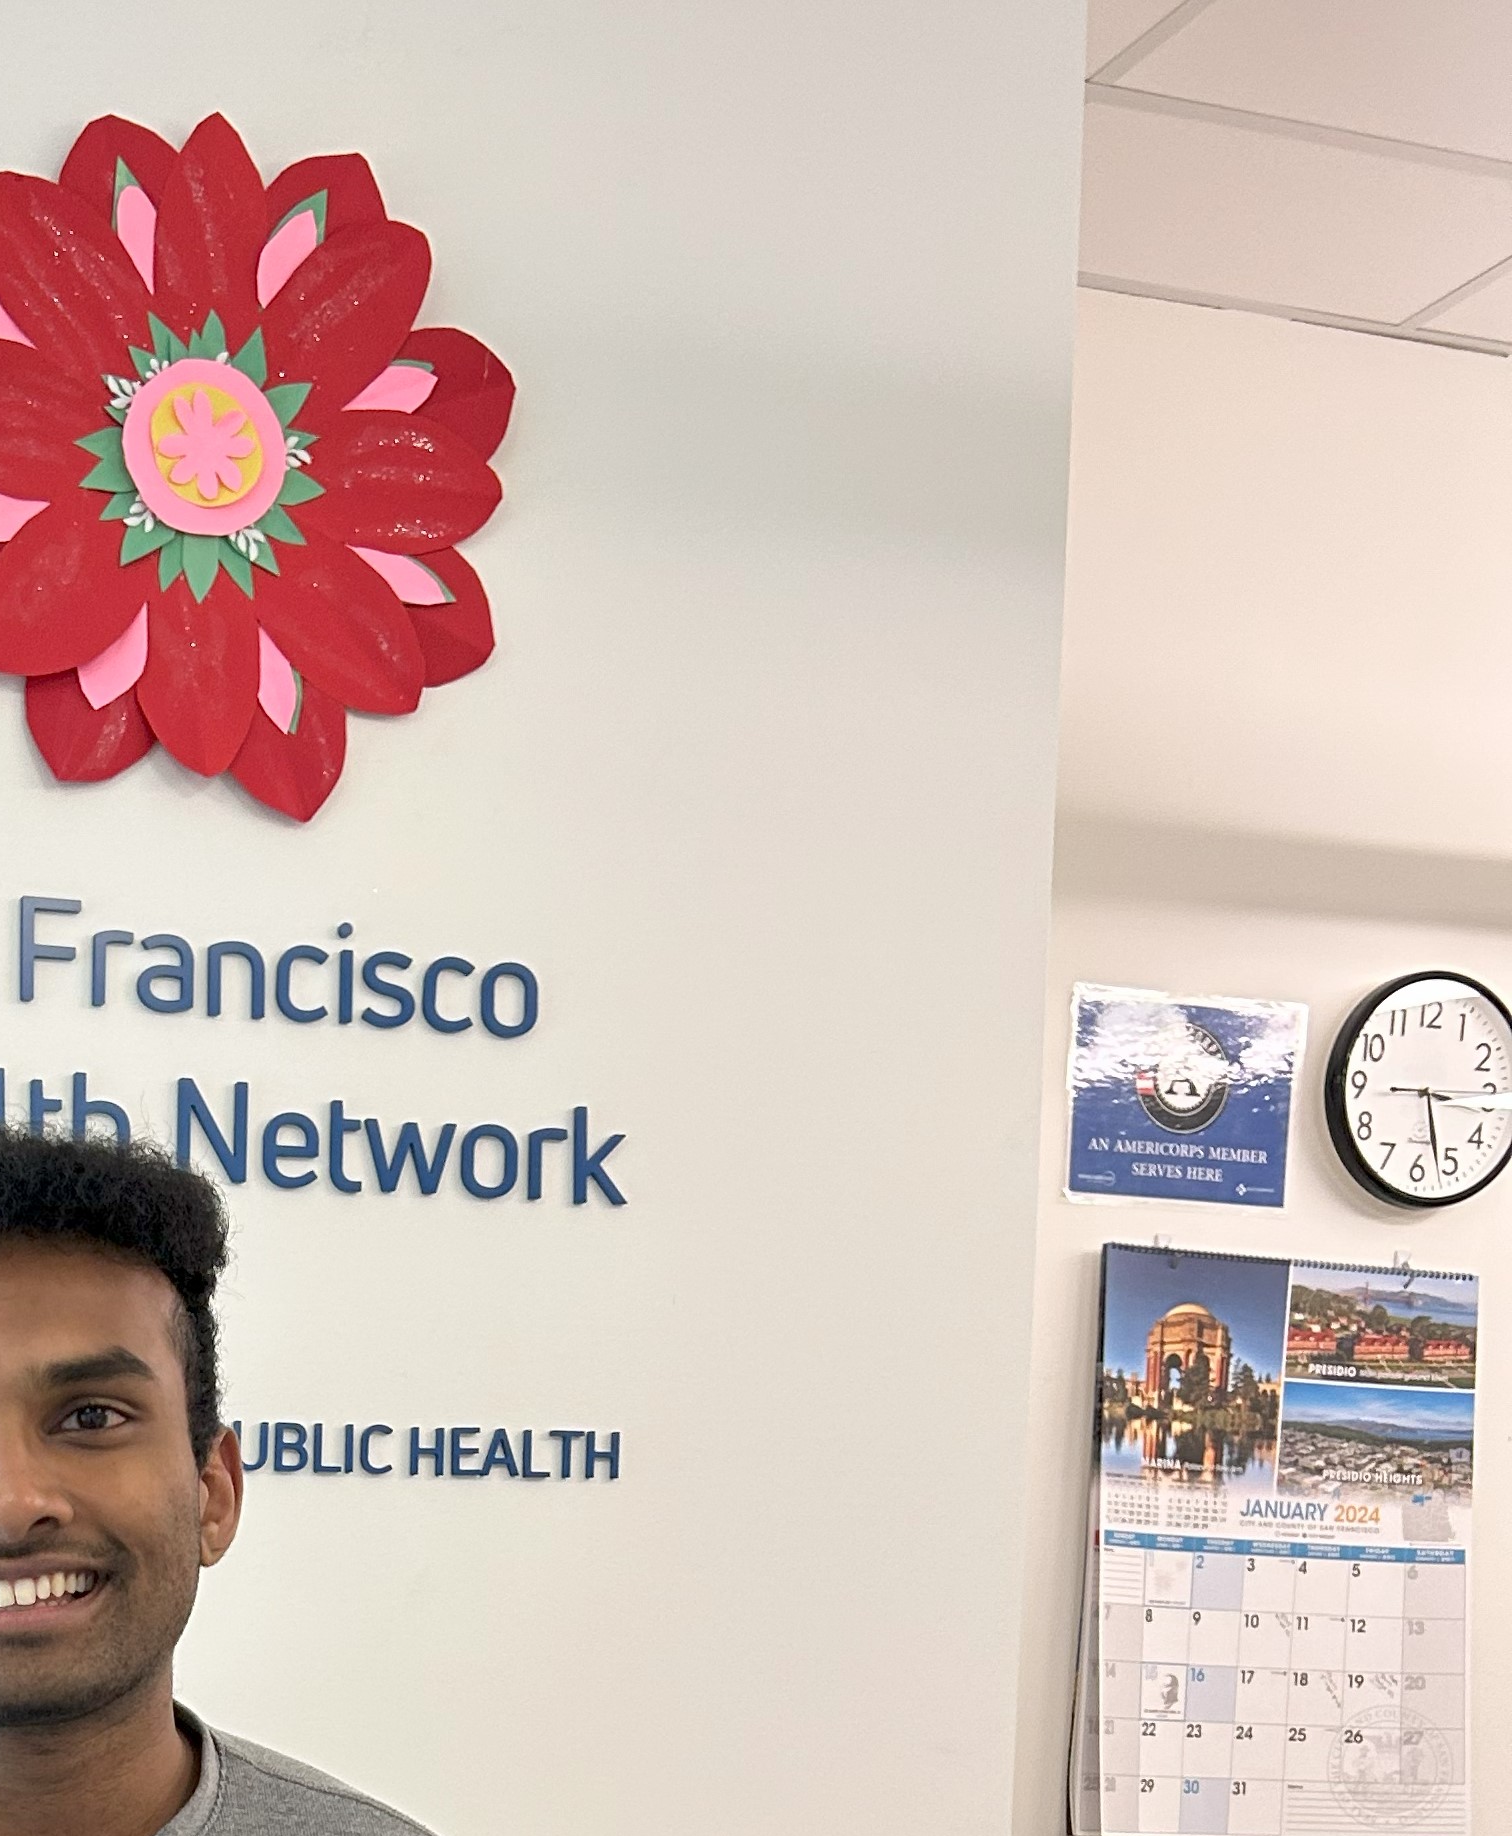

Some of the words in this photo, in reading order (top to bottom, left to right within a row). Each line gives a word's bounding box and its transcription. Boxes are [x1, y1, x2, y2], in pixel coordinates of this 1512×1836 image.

[19, 895, 539, 1038] Francisco
[1389, 1008, 1407, 1037] 11
[1420, 1001, 1443, 1029] 12
[1362, 1033, 1385, 1062] 10
[1474, 1042, 1492, 1072] 2
[1351, 1070, 1368, 1099] 9
[1357, 1111, 1372, 1141] 8
[176, 1076, 628, 1206] Network
[1467, 1122, 1485, 1150] 4
[1088, 1137, 1109, 1151] AN
[1113, 1138, 1205, 1160] AMERICORPS
[1208, 1147, 1268, 1165] MEMBER
[1379, 1142, 1397, 1171] 7
[1409, 1153, 1426, 1183] 6
[1442, 1147, 1459, 1176] 5
[1131, 1162, 1183, 1179] SERVES
[1186, 1166, 1224, 1183] HERE
[1308, 1363, 1357, 1378] PRESIDIO
[409, 1426, 621, 1479] HEALTH
[1322, 1469, 1372, 1483] PRESIDIO
[1375, 1472, 1424, 1486] HEIGHTS
[1239, 1499, 1329, 1522] JANUARY
[1334, 1504, 1381, 1524] 2024
[1196, 1555, 1204, 1569] 2
[1247, 1558, 1256, 1572] 3
[1298, 1560, 1307, 1575] 4
[1351, 1563, 1361, 1578] 5
[1407, 1565, 1418, 1580] 6
[1145, 1608, 1153, 1623] 8
[1192, 1611, 1201, 1626] 9
[1244, 1613, 1260, 1628] 10
[1297, 1616, 1309, 1631] 11
[1350, 1618, 1366, 1634] 12
[1190, 1667, 1205, 1682] 16
[1241, 1670, 1255, 1684] 17
[1293, 1672, 1308, 1687] 18
[1347, 1674, 1364, 1689] 19
[1404, 1676, 1426, 1691] 20
[1141, 1722, 1156, 1737] 22
[1186, 1724, 1202, 1738] 23
[1236, 1726, 1253, 1740] 24
[1288, 1728, 1306, 1742] 25
[1344, 1730, 1363, 1744] 26
[1403, 1731, 1424, 1746] 27
[1141, 1779, 1155, 1793] 29
[1183, 1780, 1199, 1794] 30
[1232, 1781, 1246, 1796] 31
